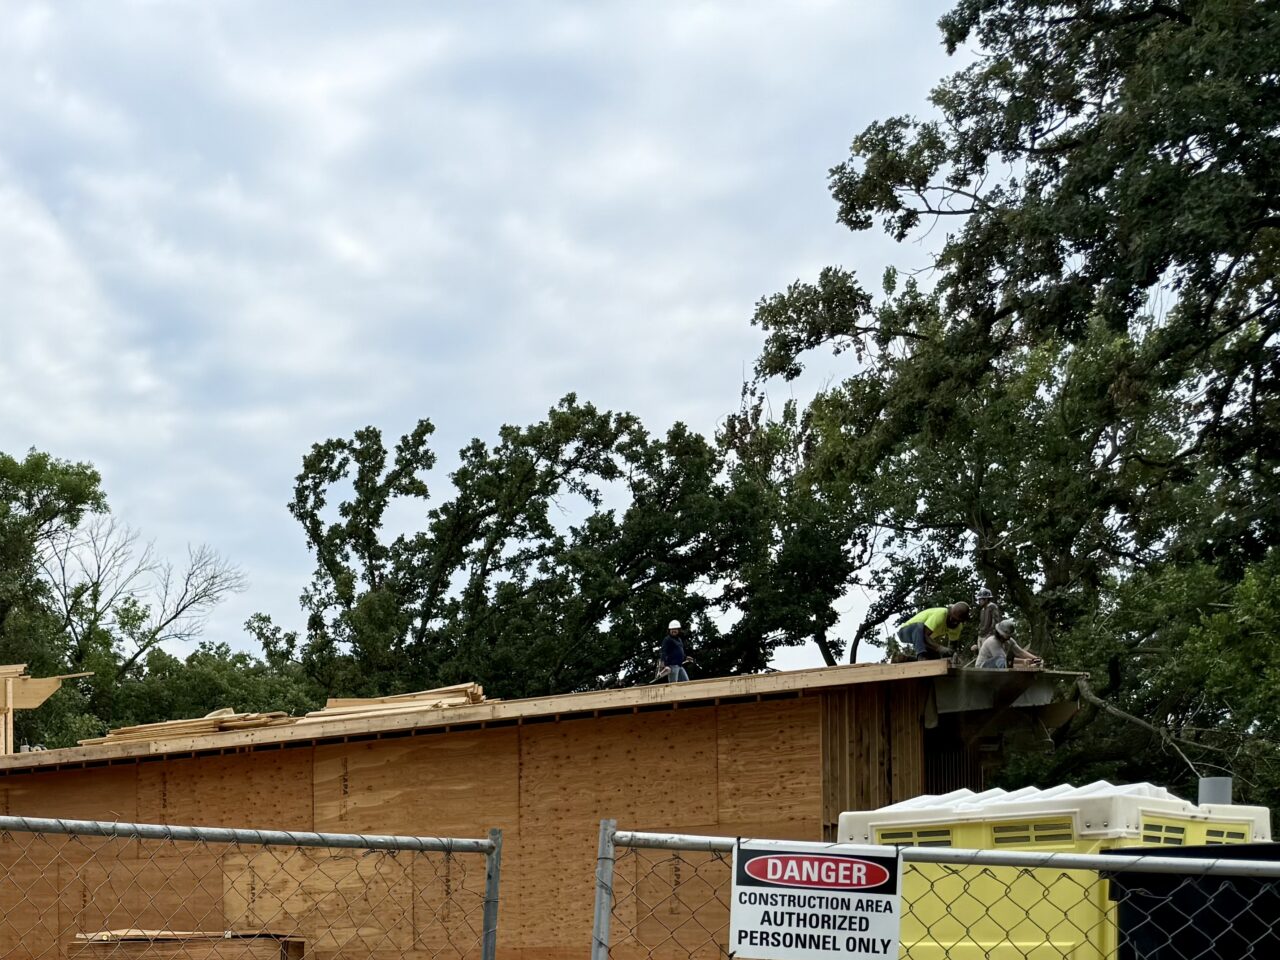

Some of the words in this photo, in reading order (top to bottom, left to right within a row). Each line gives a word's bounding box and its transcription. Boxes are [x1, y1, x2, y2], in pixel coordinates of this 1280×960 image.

[767, 859, 867, 885] DANGER
[738, 891, 851, 911] CONSTRUCTION
[855, 898, 893, 914] AREA
[760, 910, 870, 932] AUTHORIZED
[737, 930, 840, 951] PERSONNEL
[845, 936, 892, 955] ONLY
